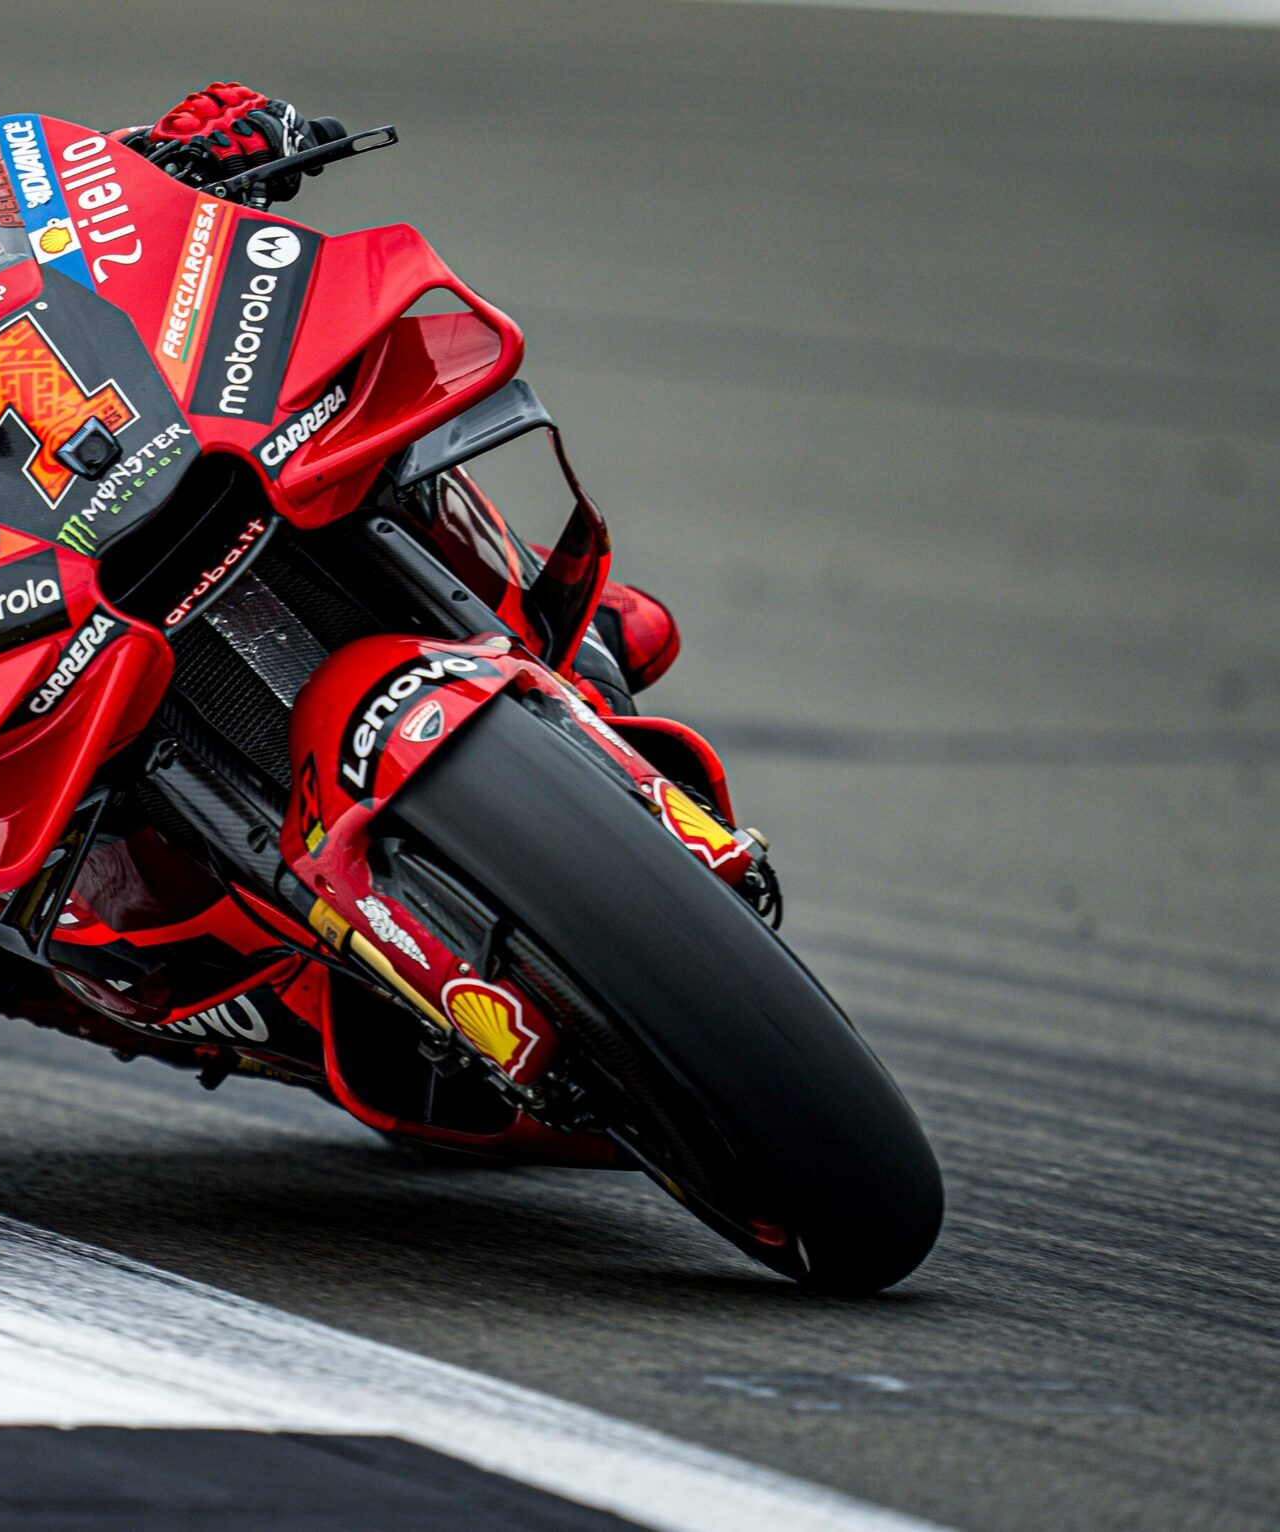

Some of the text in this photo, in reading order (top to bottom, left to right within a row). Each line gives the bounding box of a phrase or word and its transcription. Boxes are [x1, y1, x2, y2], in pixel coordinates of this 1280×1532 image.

[2, 119, 54, 205] ADVANCE
[162, 202, 219, 359] FRECCIAROSSA
[218, 273, 278, 415] motorola
[80, 421, 192, 522] MONSTER
[259, 384, 347, 467] CARRERA
[110, 447, 184, 515] ENERGY
[165, 517, 266, 627] aruba.it
[29, 613, 116, 714] CARRERA
[341, 657, 478, 790] Lenovo
